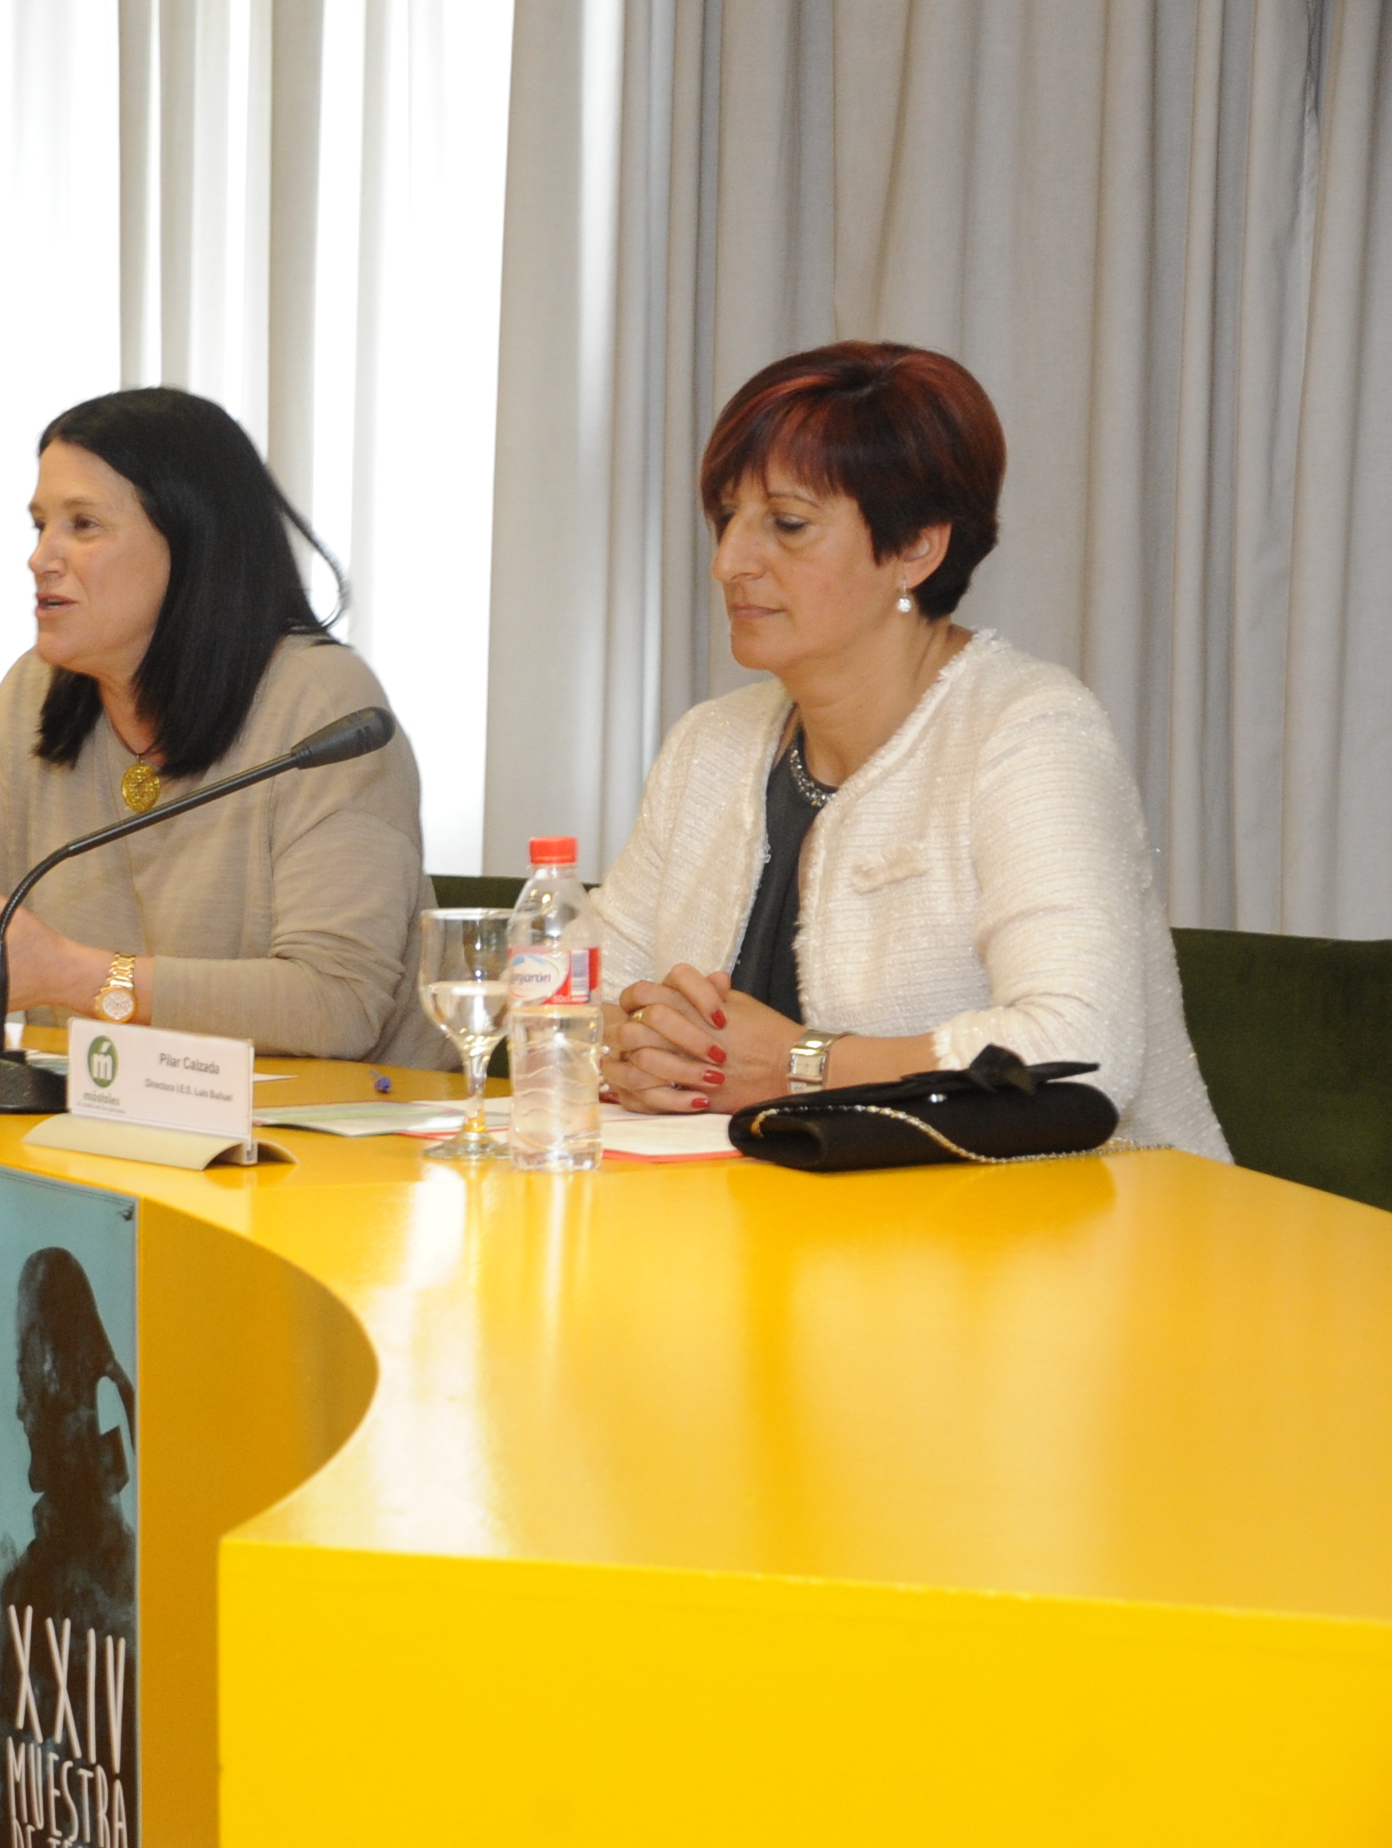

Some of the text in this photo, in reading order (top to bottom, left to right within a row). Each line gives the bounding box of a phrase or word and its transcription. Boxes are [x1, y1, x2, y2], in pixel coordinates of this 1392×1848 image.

[160, 1052, 220, 1075] Pilar Calzada
[84, 1089, 120, 1106] móstoles
[8, 1604, 126, 1774] XXIV
[7, 1736, 128, 1848] MUESTRA
